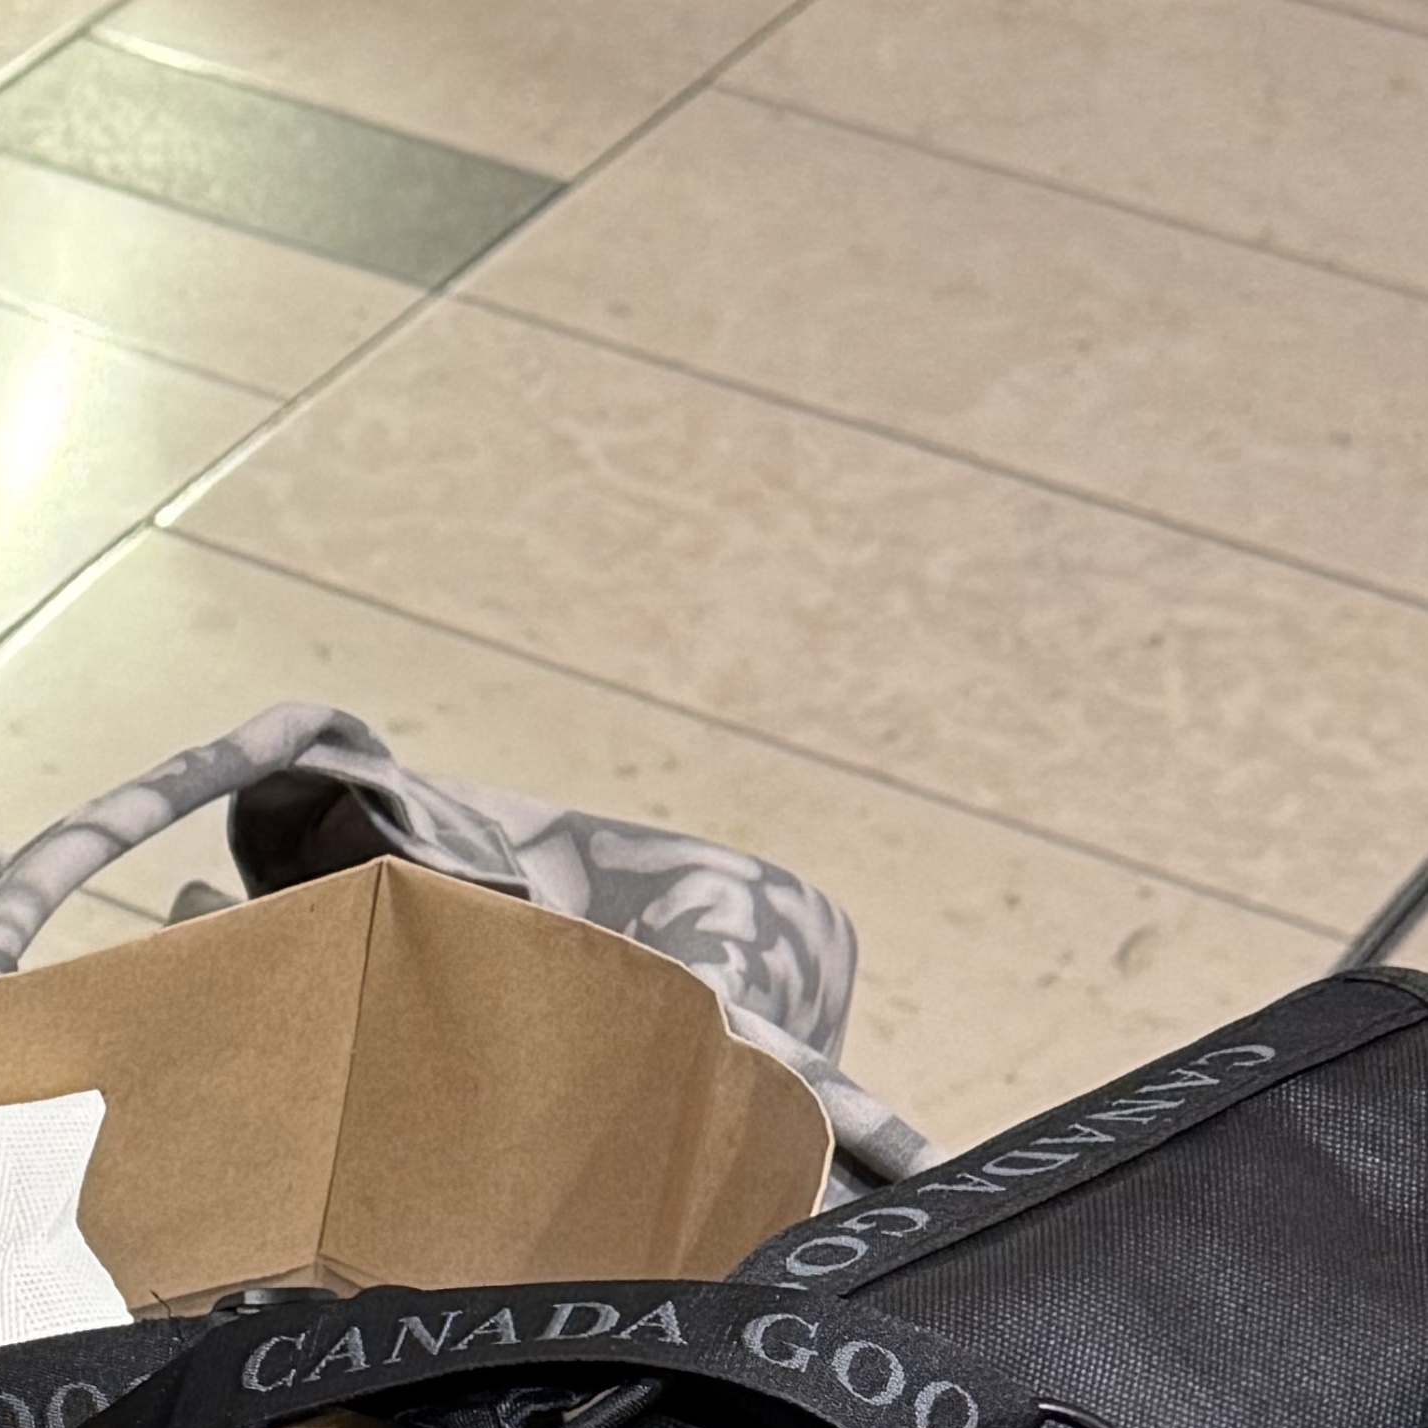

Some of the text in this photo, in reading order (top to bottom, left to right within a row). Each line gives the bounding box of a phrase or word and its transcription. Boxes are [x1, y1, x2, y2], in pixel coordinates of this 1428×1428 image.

[773, 1043, 1276, 1291] CANADA GO
[241, 1299, 689, 1393] CANADA
